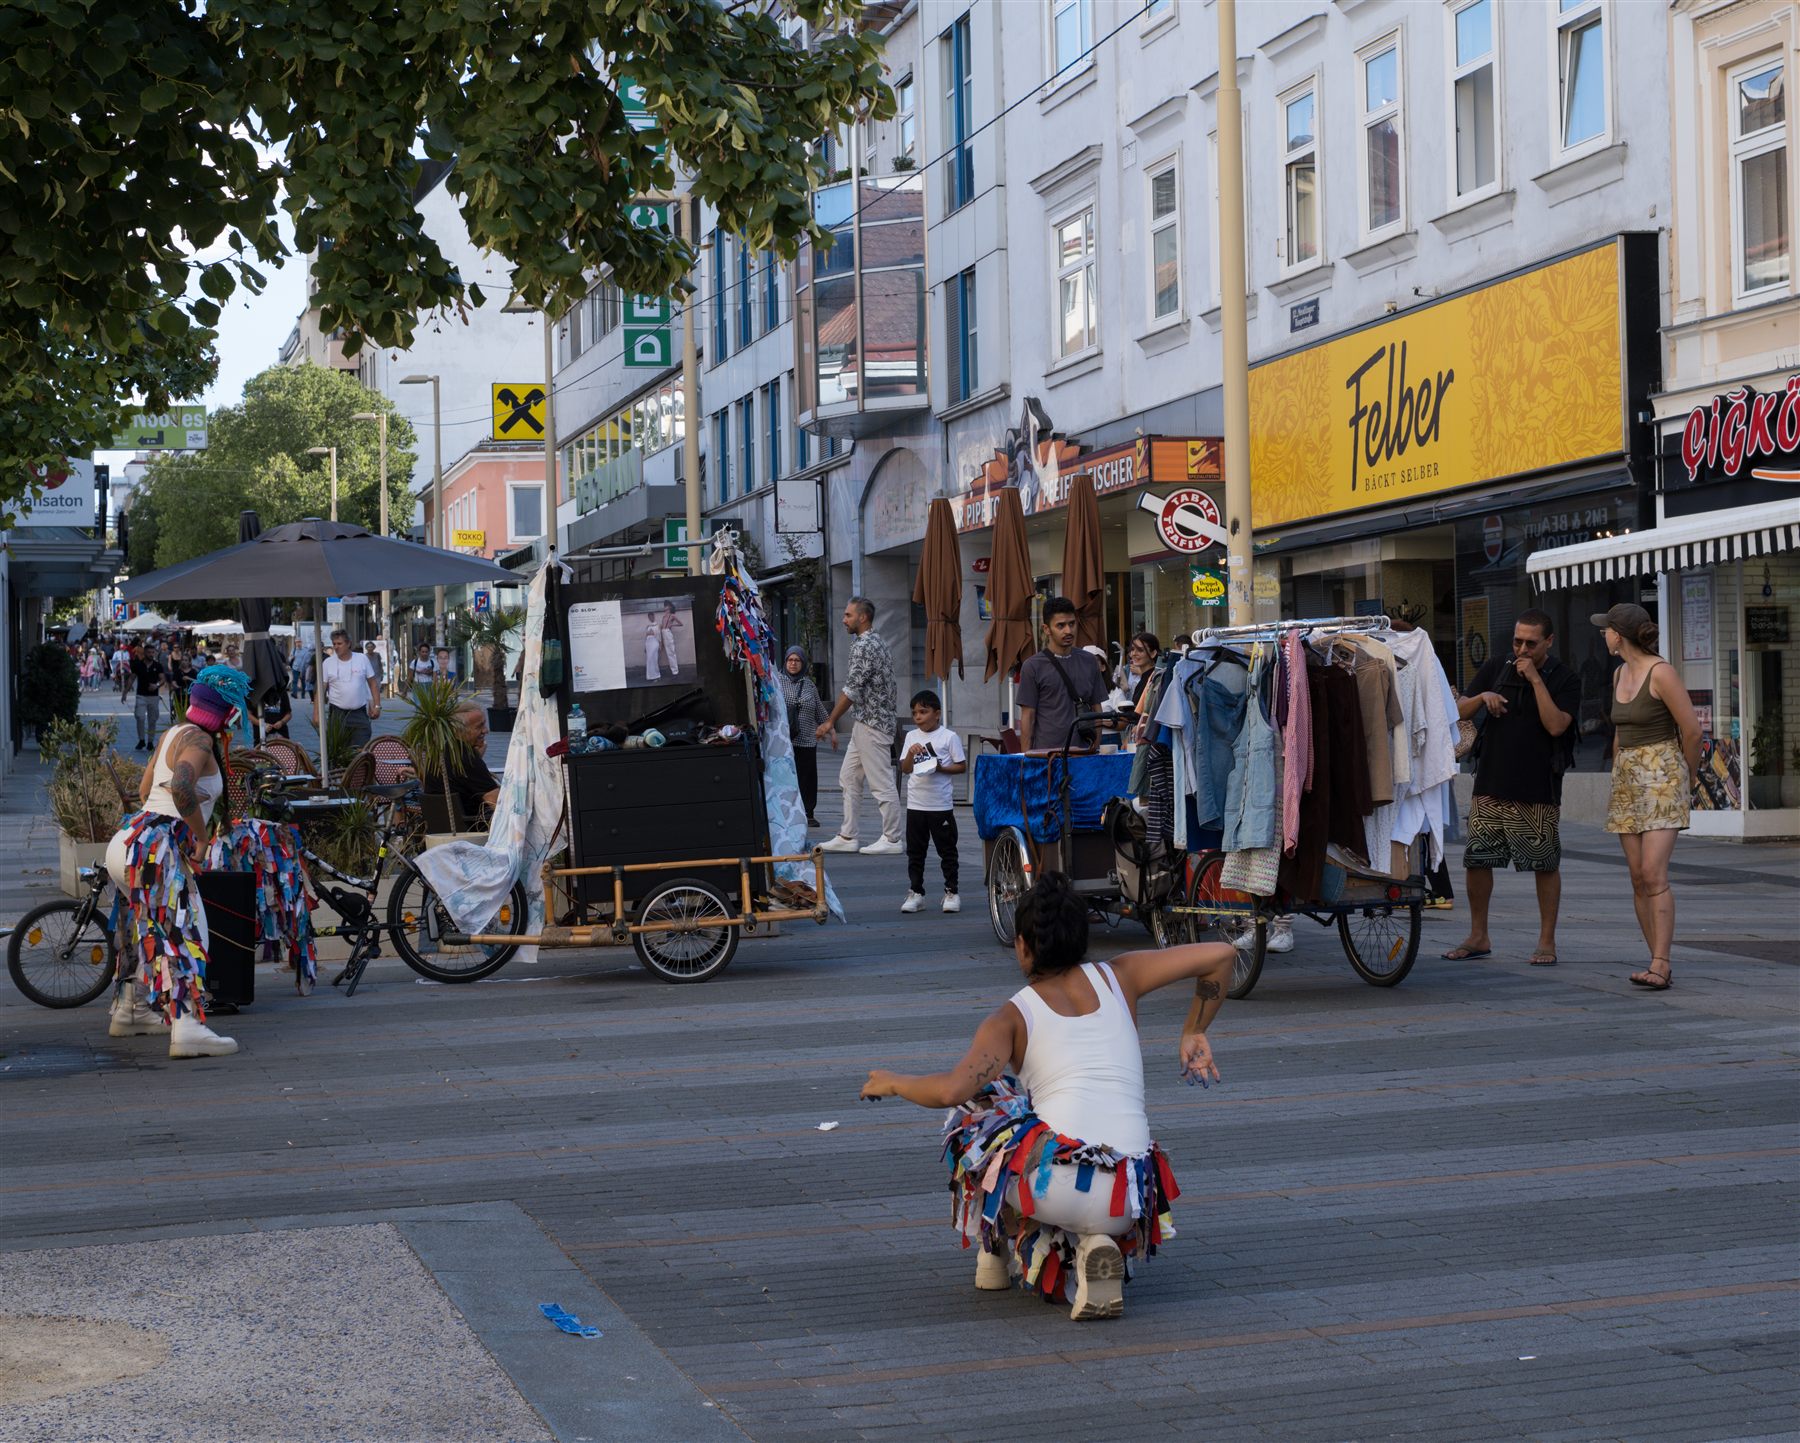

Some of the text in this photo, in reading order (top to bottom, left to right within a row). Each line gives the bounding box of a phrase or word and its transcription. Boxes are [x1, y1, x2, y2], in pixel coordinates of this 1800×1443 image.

[1346, 340, 1455, 491] Felber
[1365, 462, 1439, 491] BÄCKT SELBER
[1171, 493, 1216, 520] TABAK
[1164, 515, 1205, 549] TRAFIK
[1195, 585, 1221, 594] Jackpot
